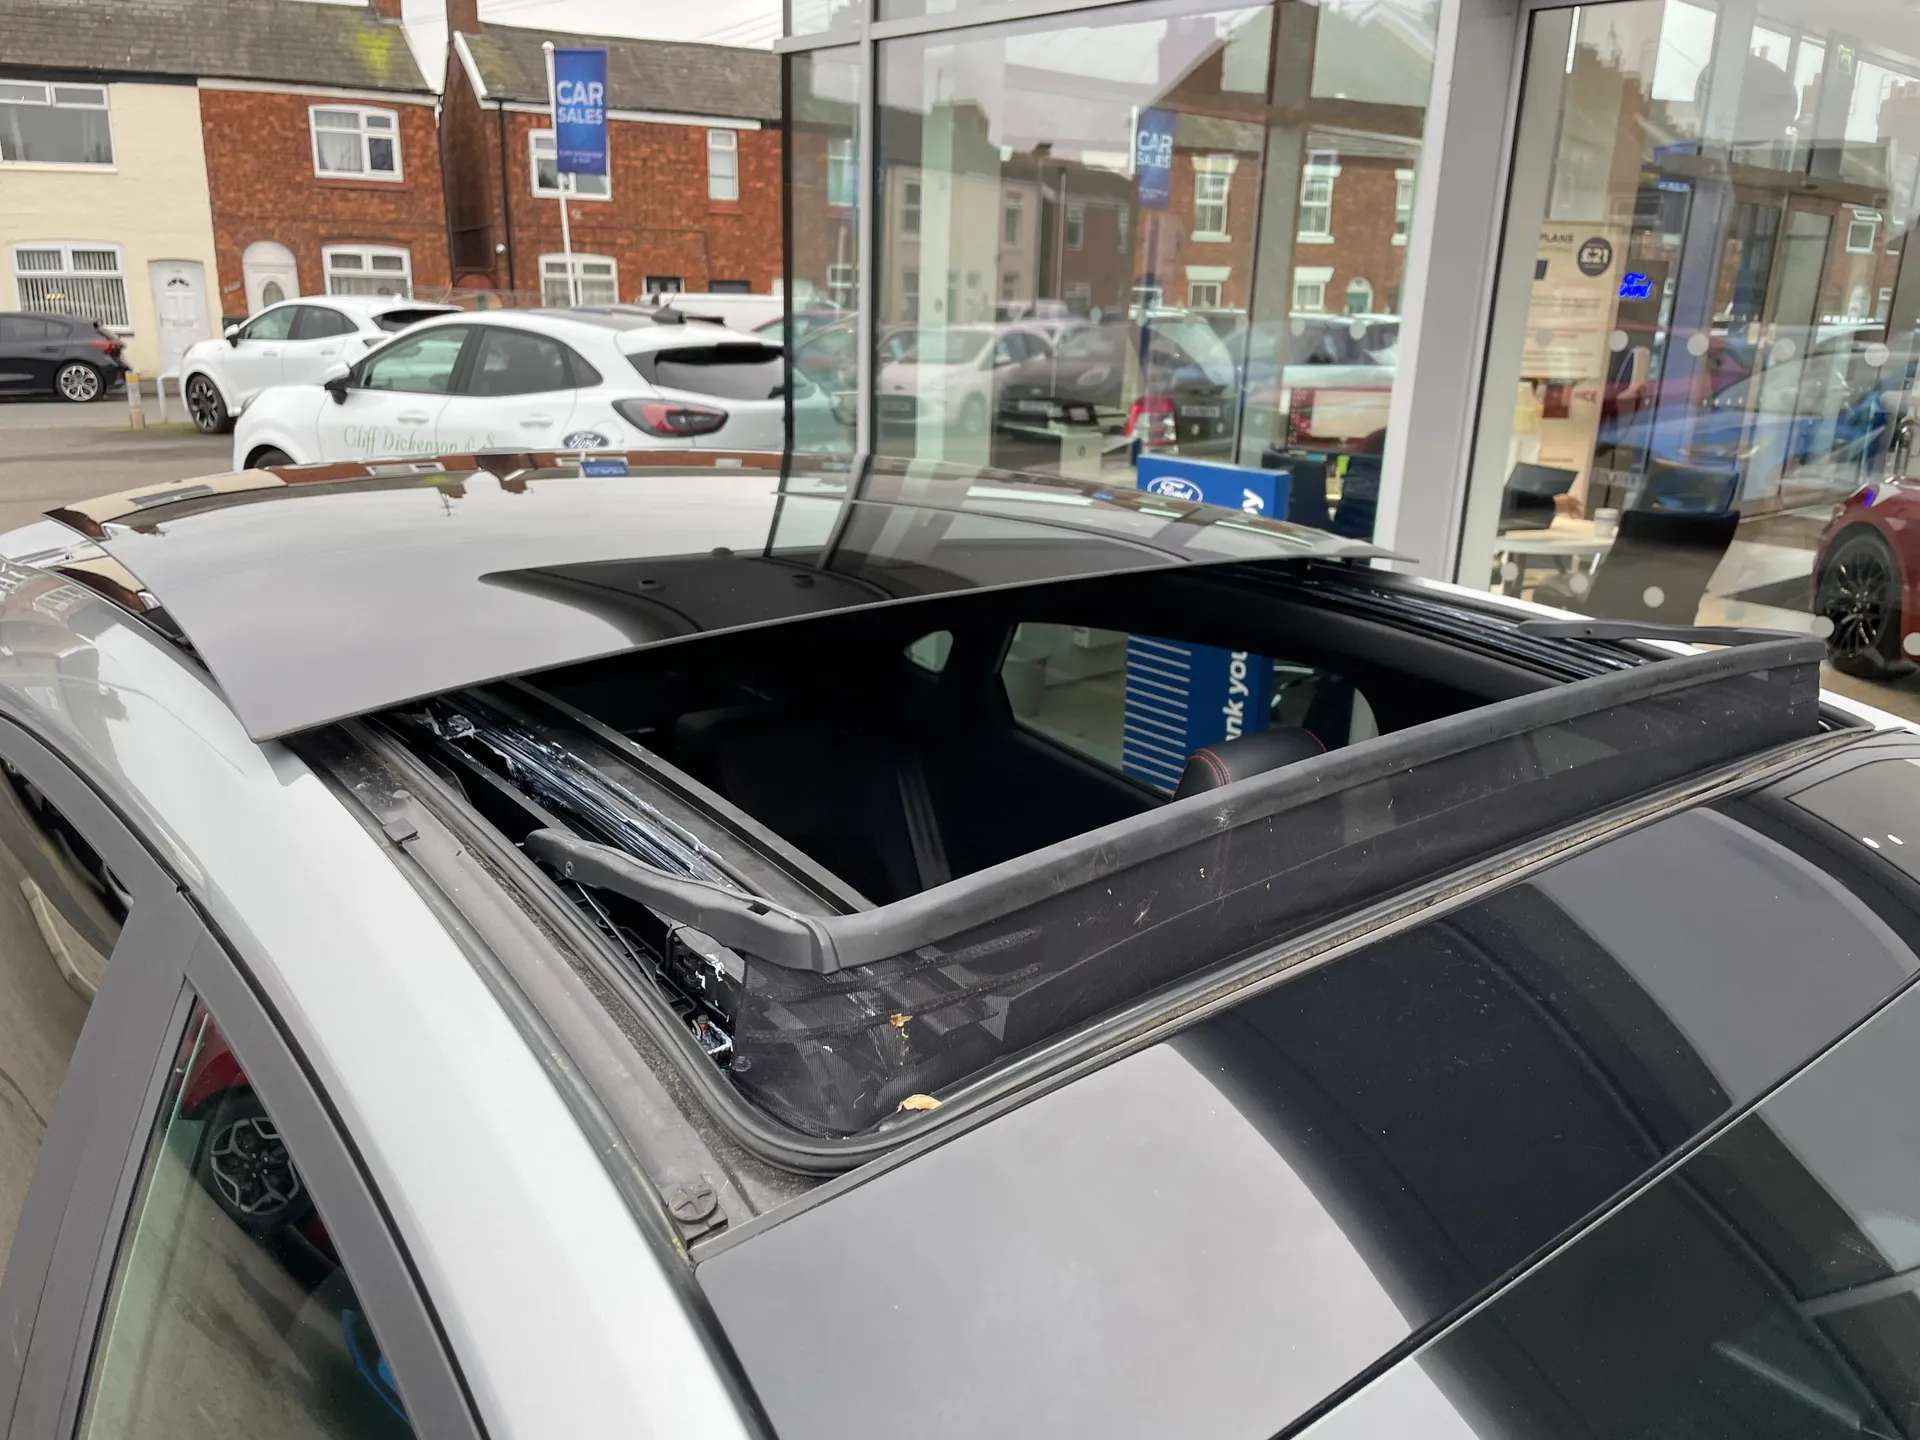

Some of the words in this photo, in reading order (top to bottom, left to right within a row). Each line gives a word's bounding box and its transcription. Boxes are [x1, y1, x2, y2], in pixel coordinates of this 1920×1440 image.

[557, 80, 604, 106] CAR
[557, 106, 603, 125] SALES
[1138, 130, 1173, 153] CAR
[1618, 272, 1655, 299] Ford
[344, 423, 379, 454] Cliff
[568, 432, 603, 448] Ford
[1155, 479, 1196, 501] Ford
